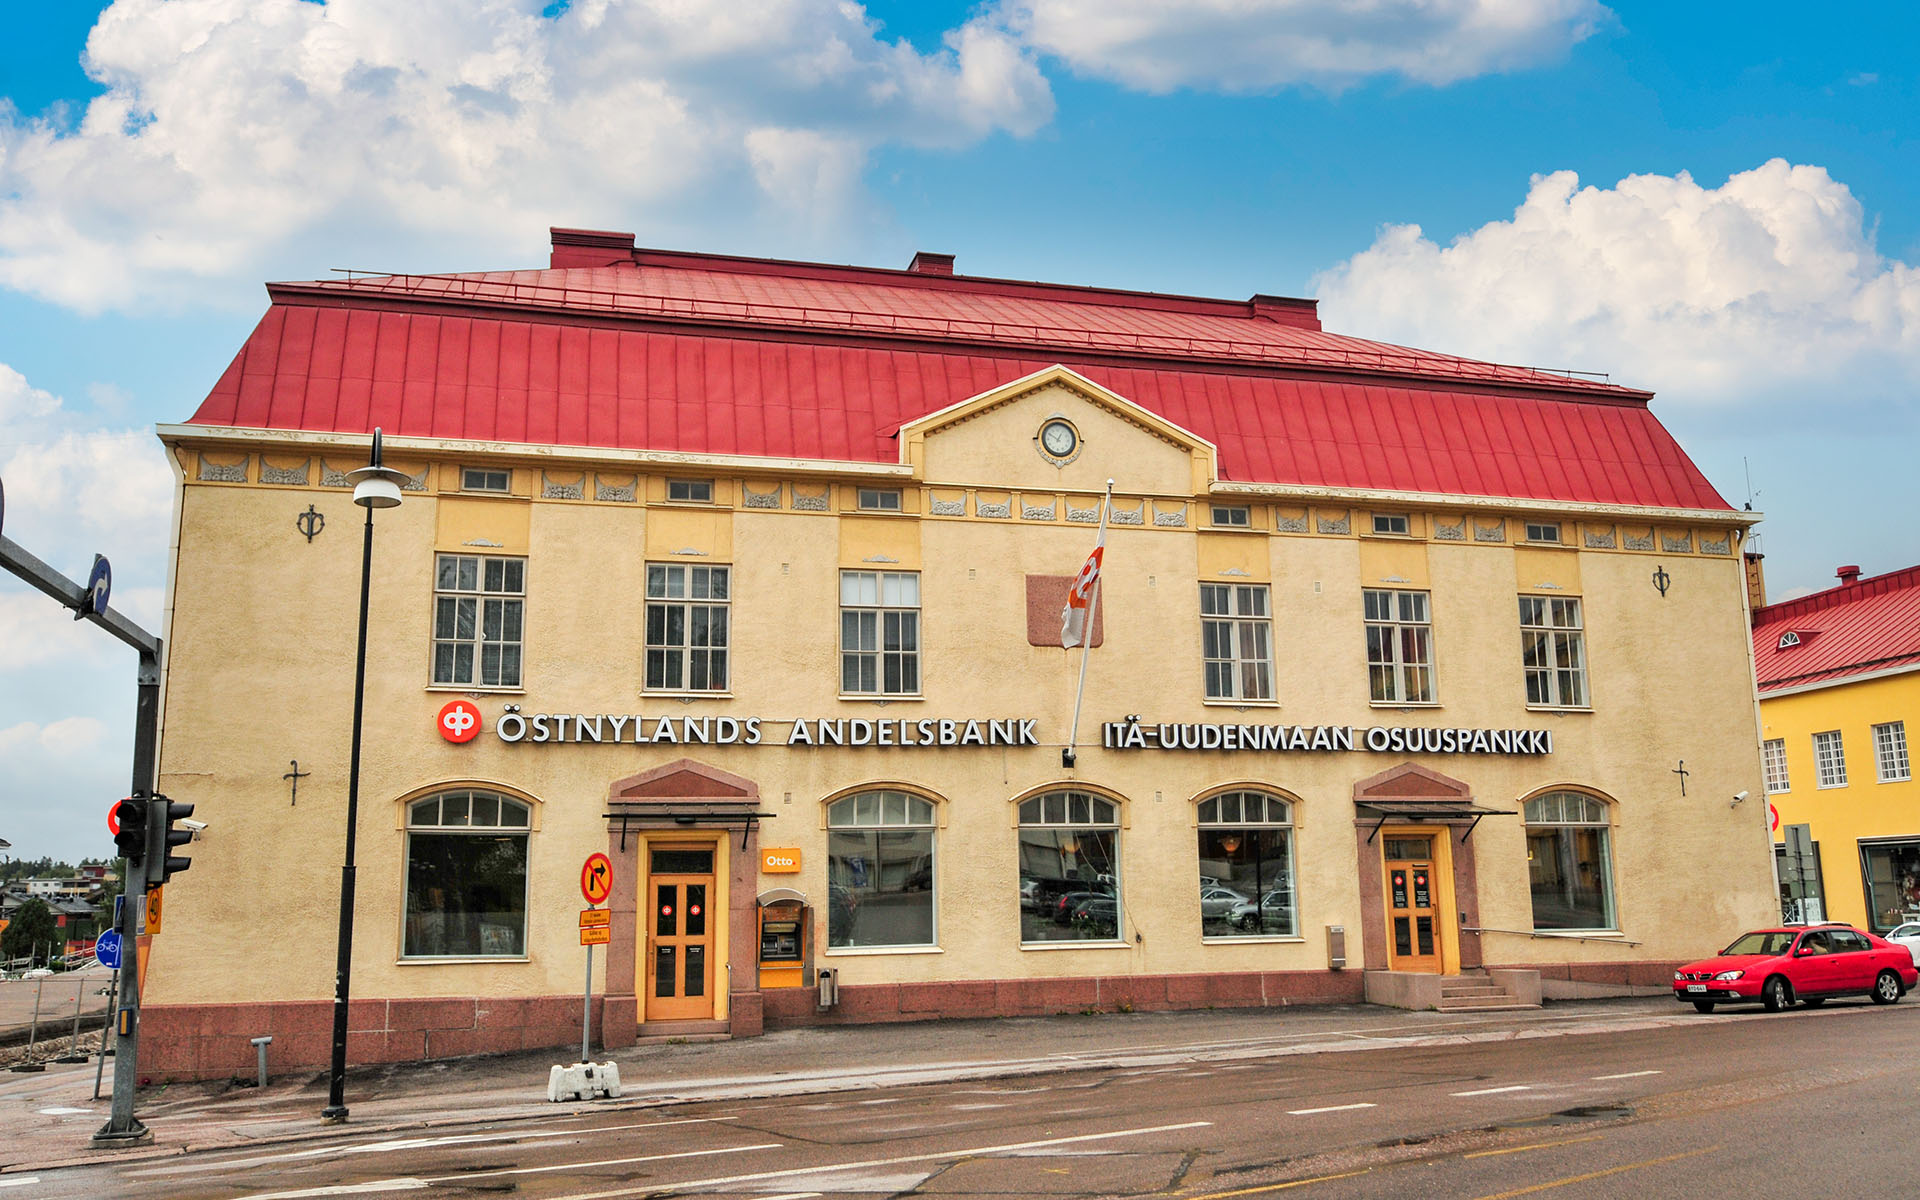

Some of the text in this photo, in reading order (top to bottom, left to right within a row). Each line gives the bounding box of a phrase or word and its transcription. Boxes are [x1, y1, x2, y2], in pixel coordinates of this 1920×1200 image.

[496, 704, 1040, 747] ÖSTNYLANDS ANDELSBANK
[1102, 714, 1553, 755] ITÄ-UUDENMAAN OSUUSPANKKI
